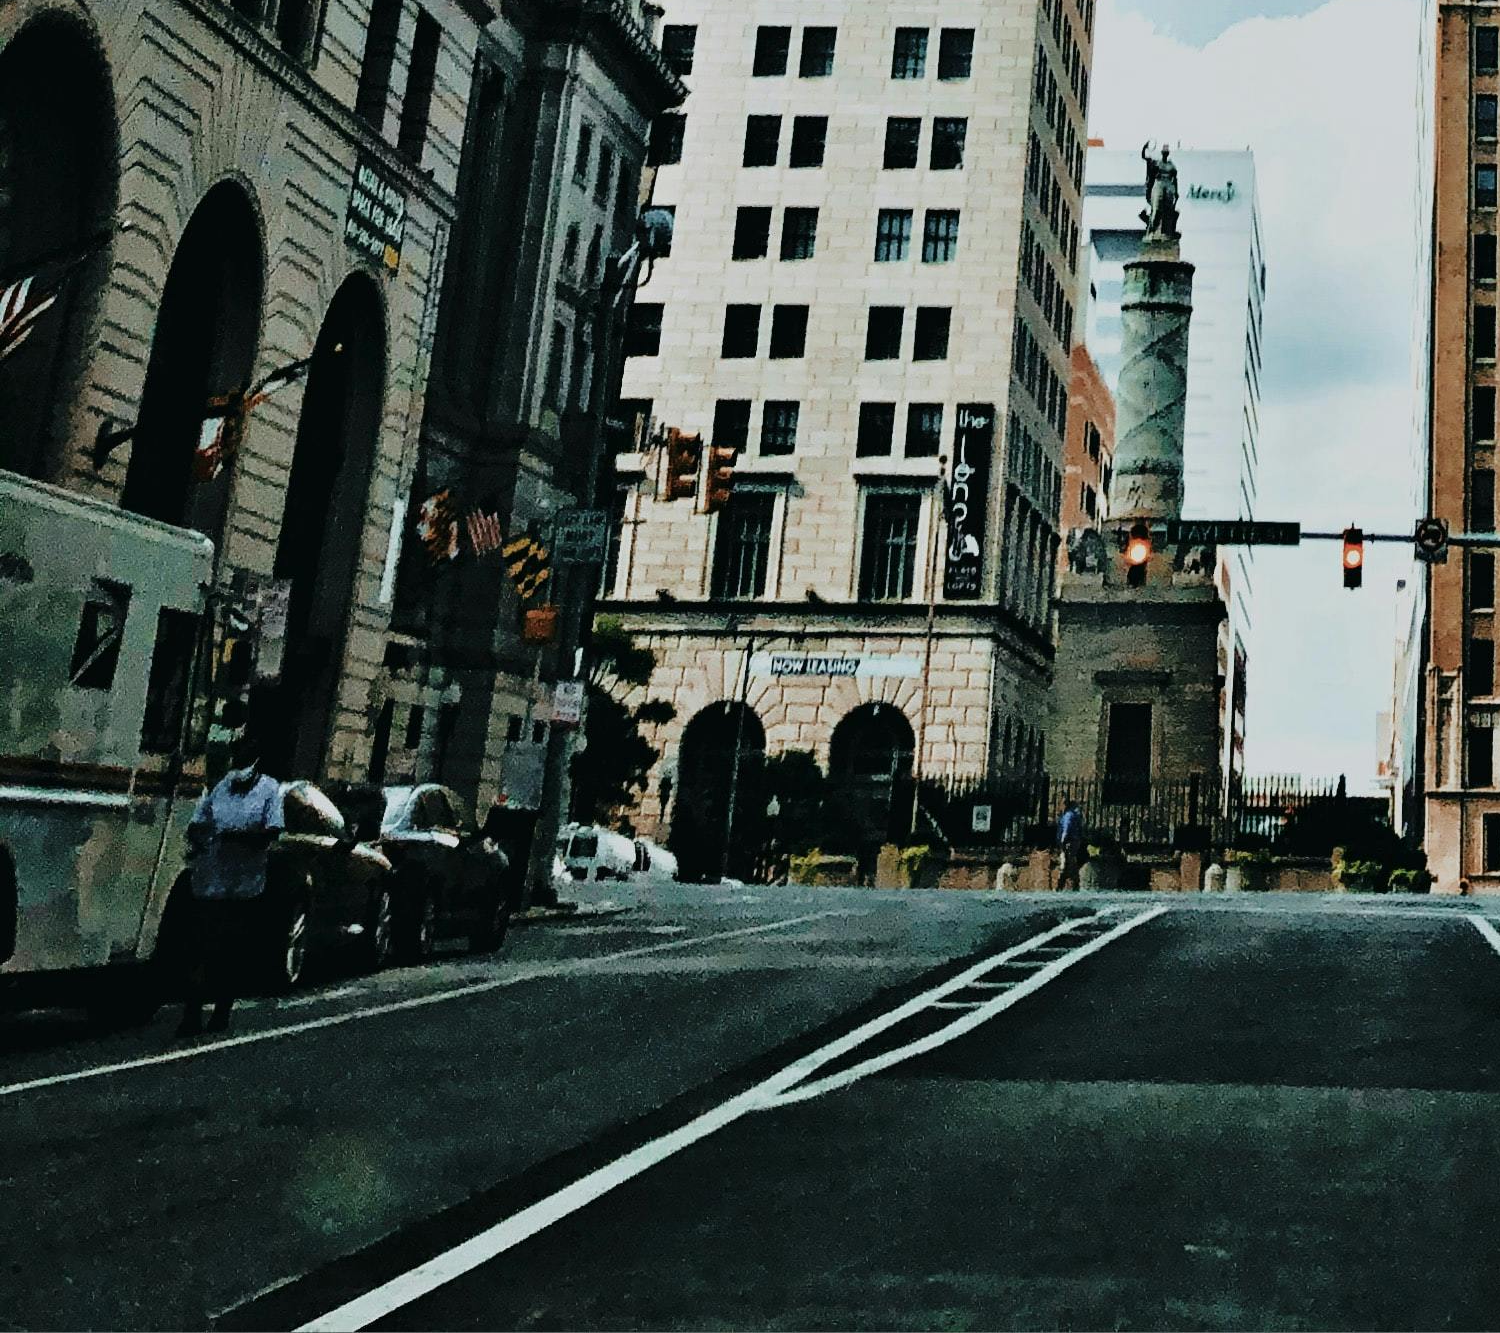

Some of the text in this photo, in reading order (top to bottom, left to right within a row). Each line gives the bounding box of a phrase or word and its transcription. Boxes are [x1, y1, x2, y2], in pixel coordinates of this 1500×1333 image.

[1187, 182, 1235, 203] Mercy
[773, 659, 859, 675] NOW LEASING
